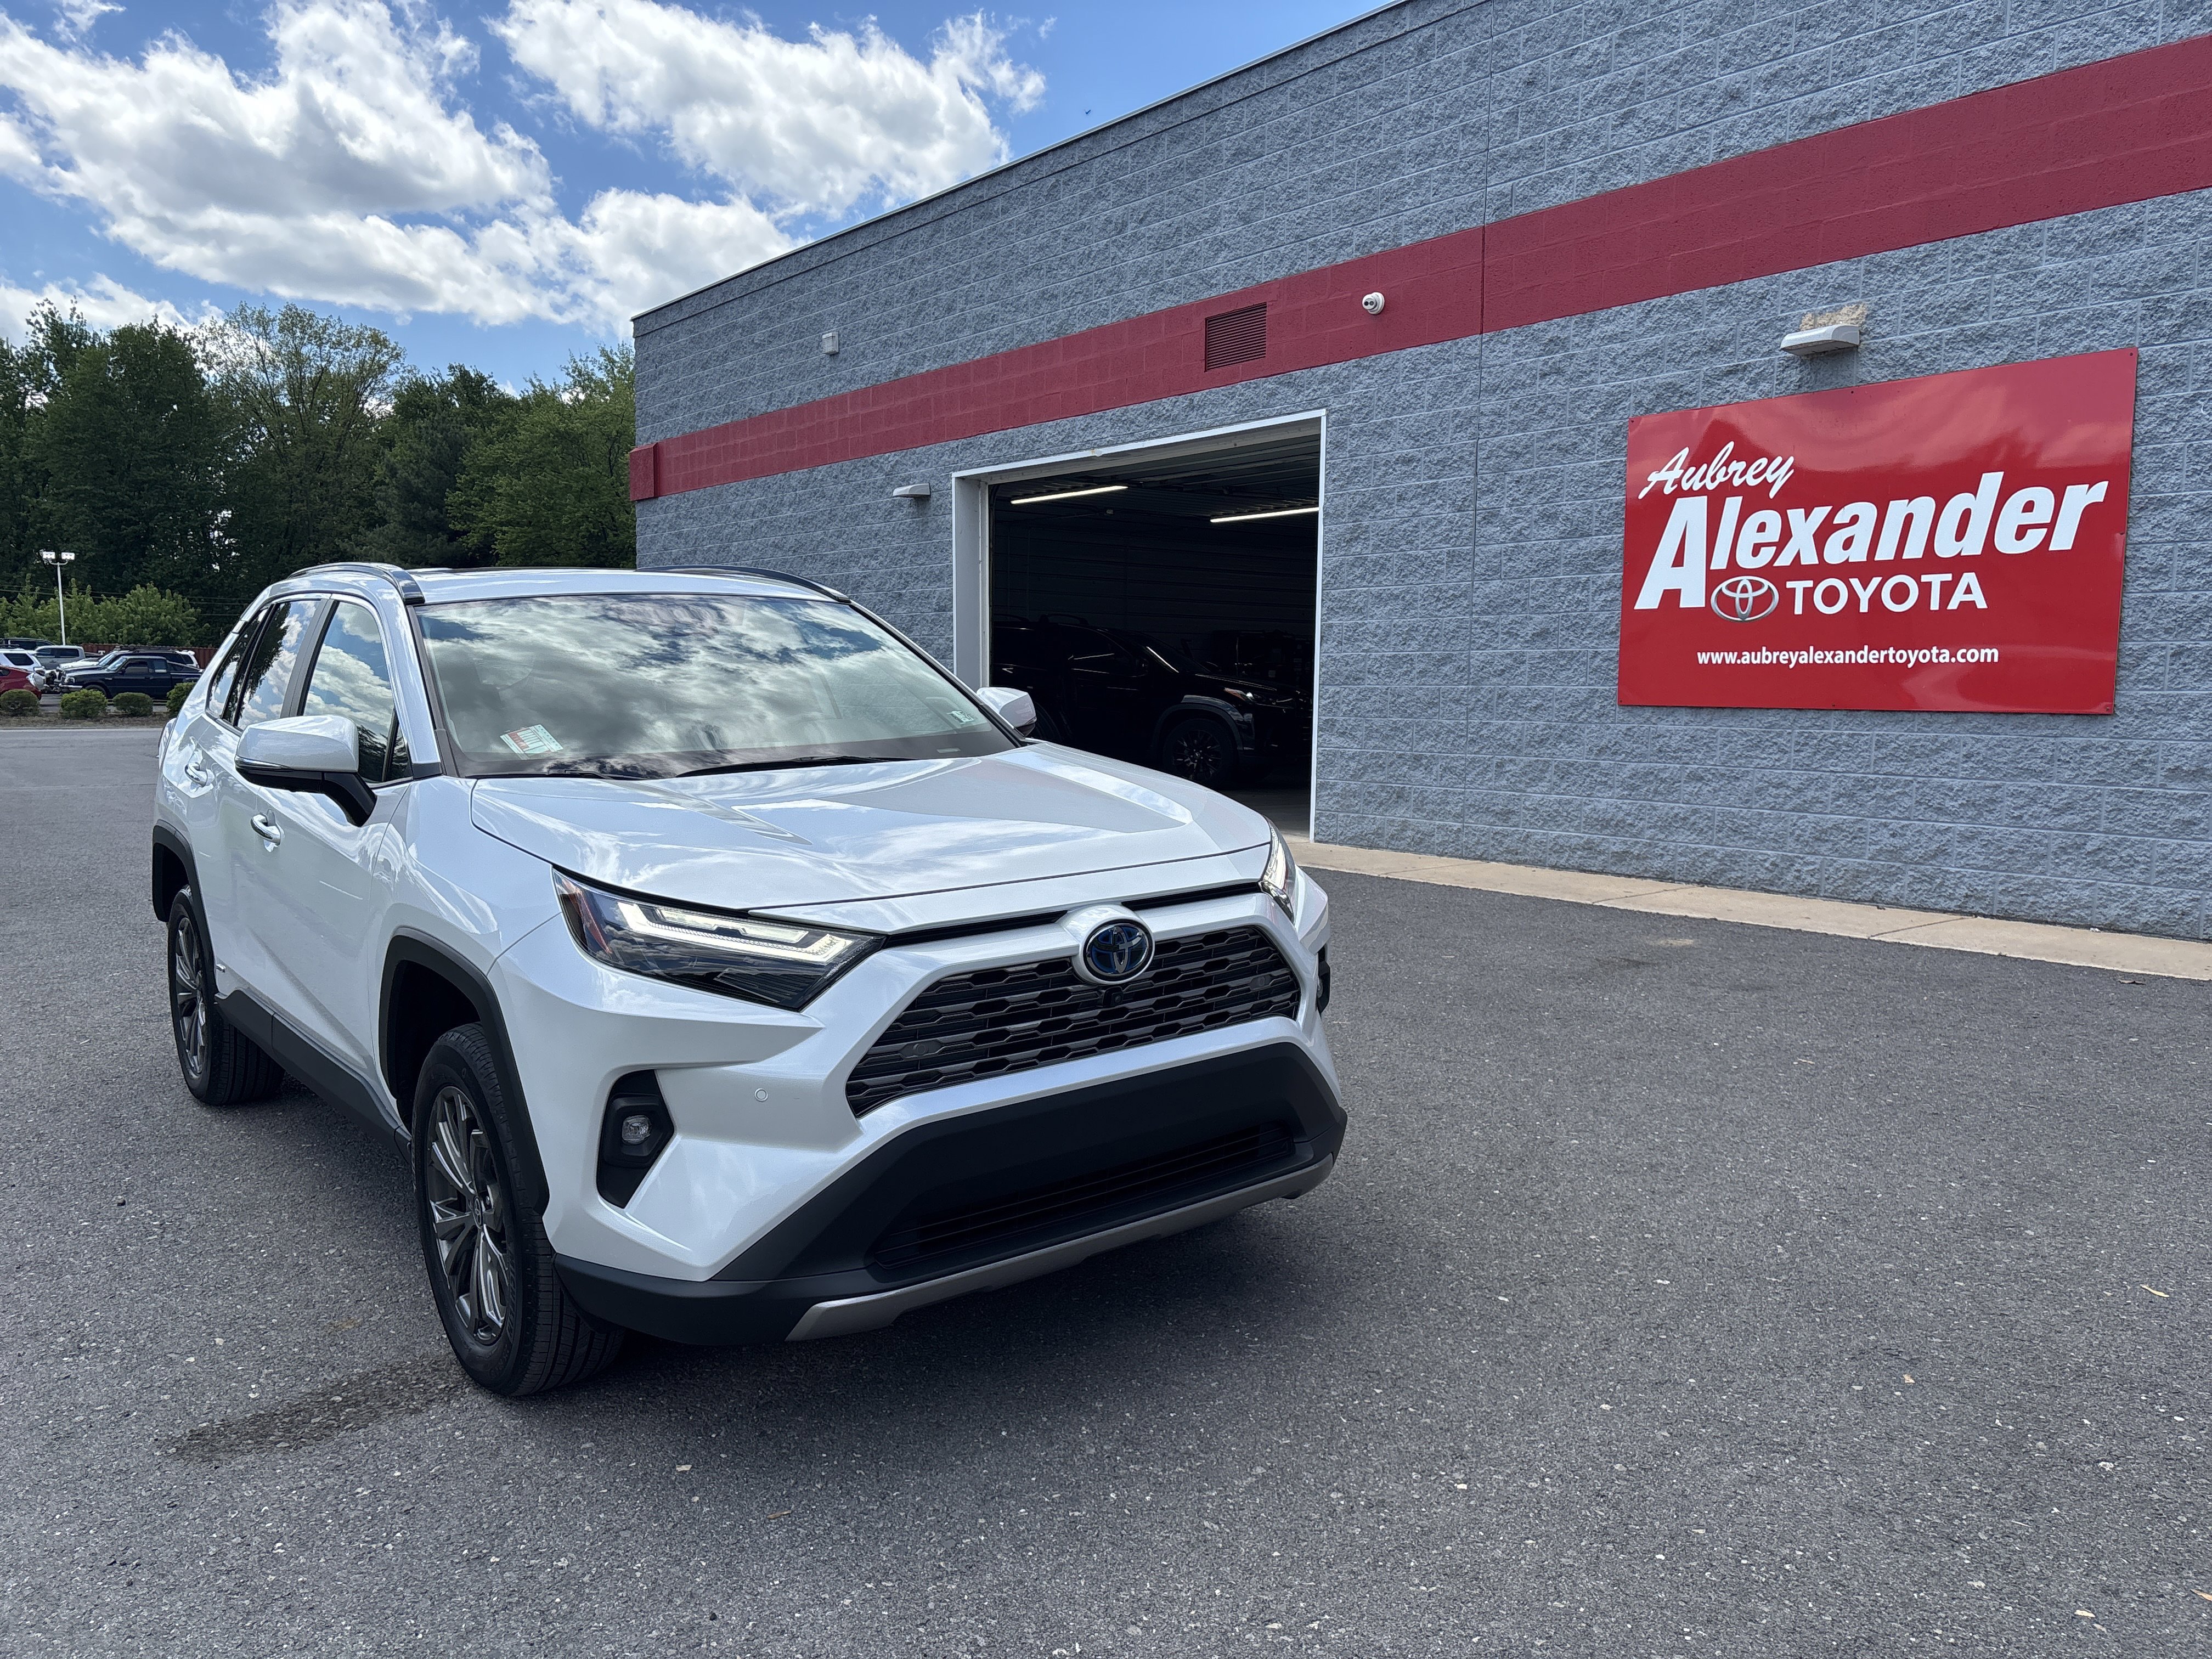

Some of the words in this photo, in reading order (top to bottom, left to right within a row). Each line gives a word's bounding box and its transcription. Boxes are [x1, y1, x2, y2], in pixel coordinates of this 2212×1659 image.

[1638, 441, 1795, 499] Aubrey
[1634, 471, 2109, 610] Alexander
[1786, 572, 1988, 615] TOYOTA
[1697, 645, 1999, 669] www.aubreyalexandertoyota.com
